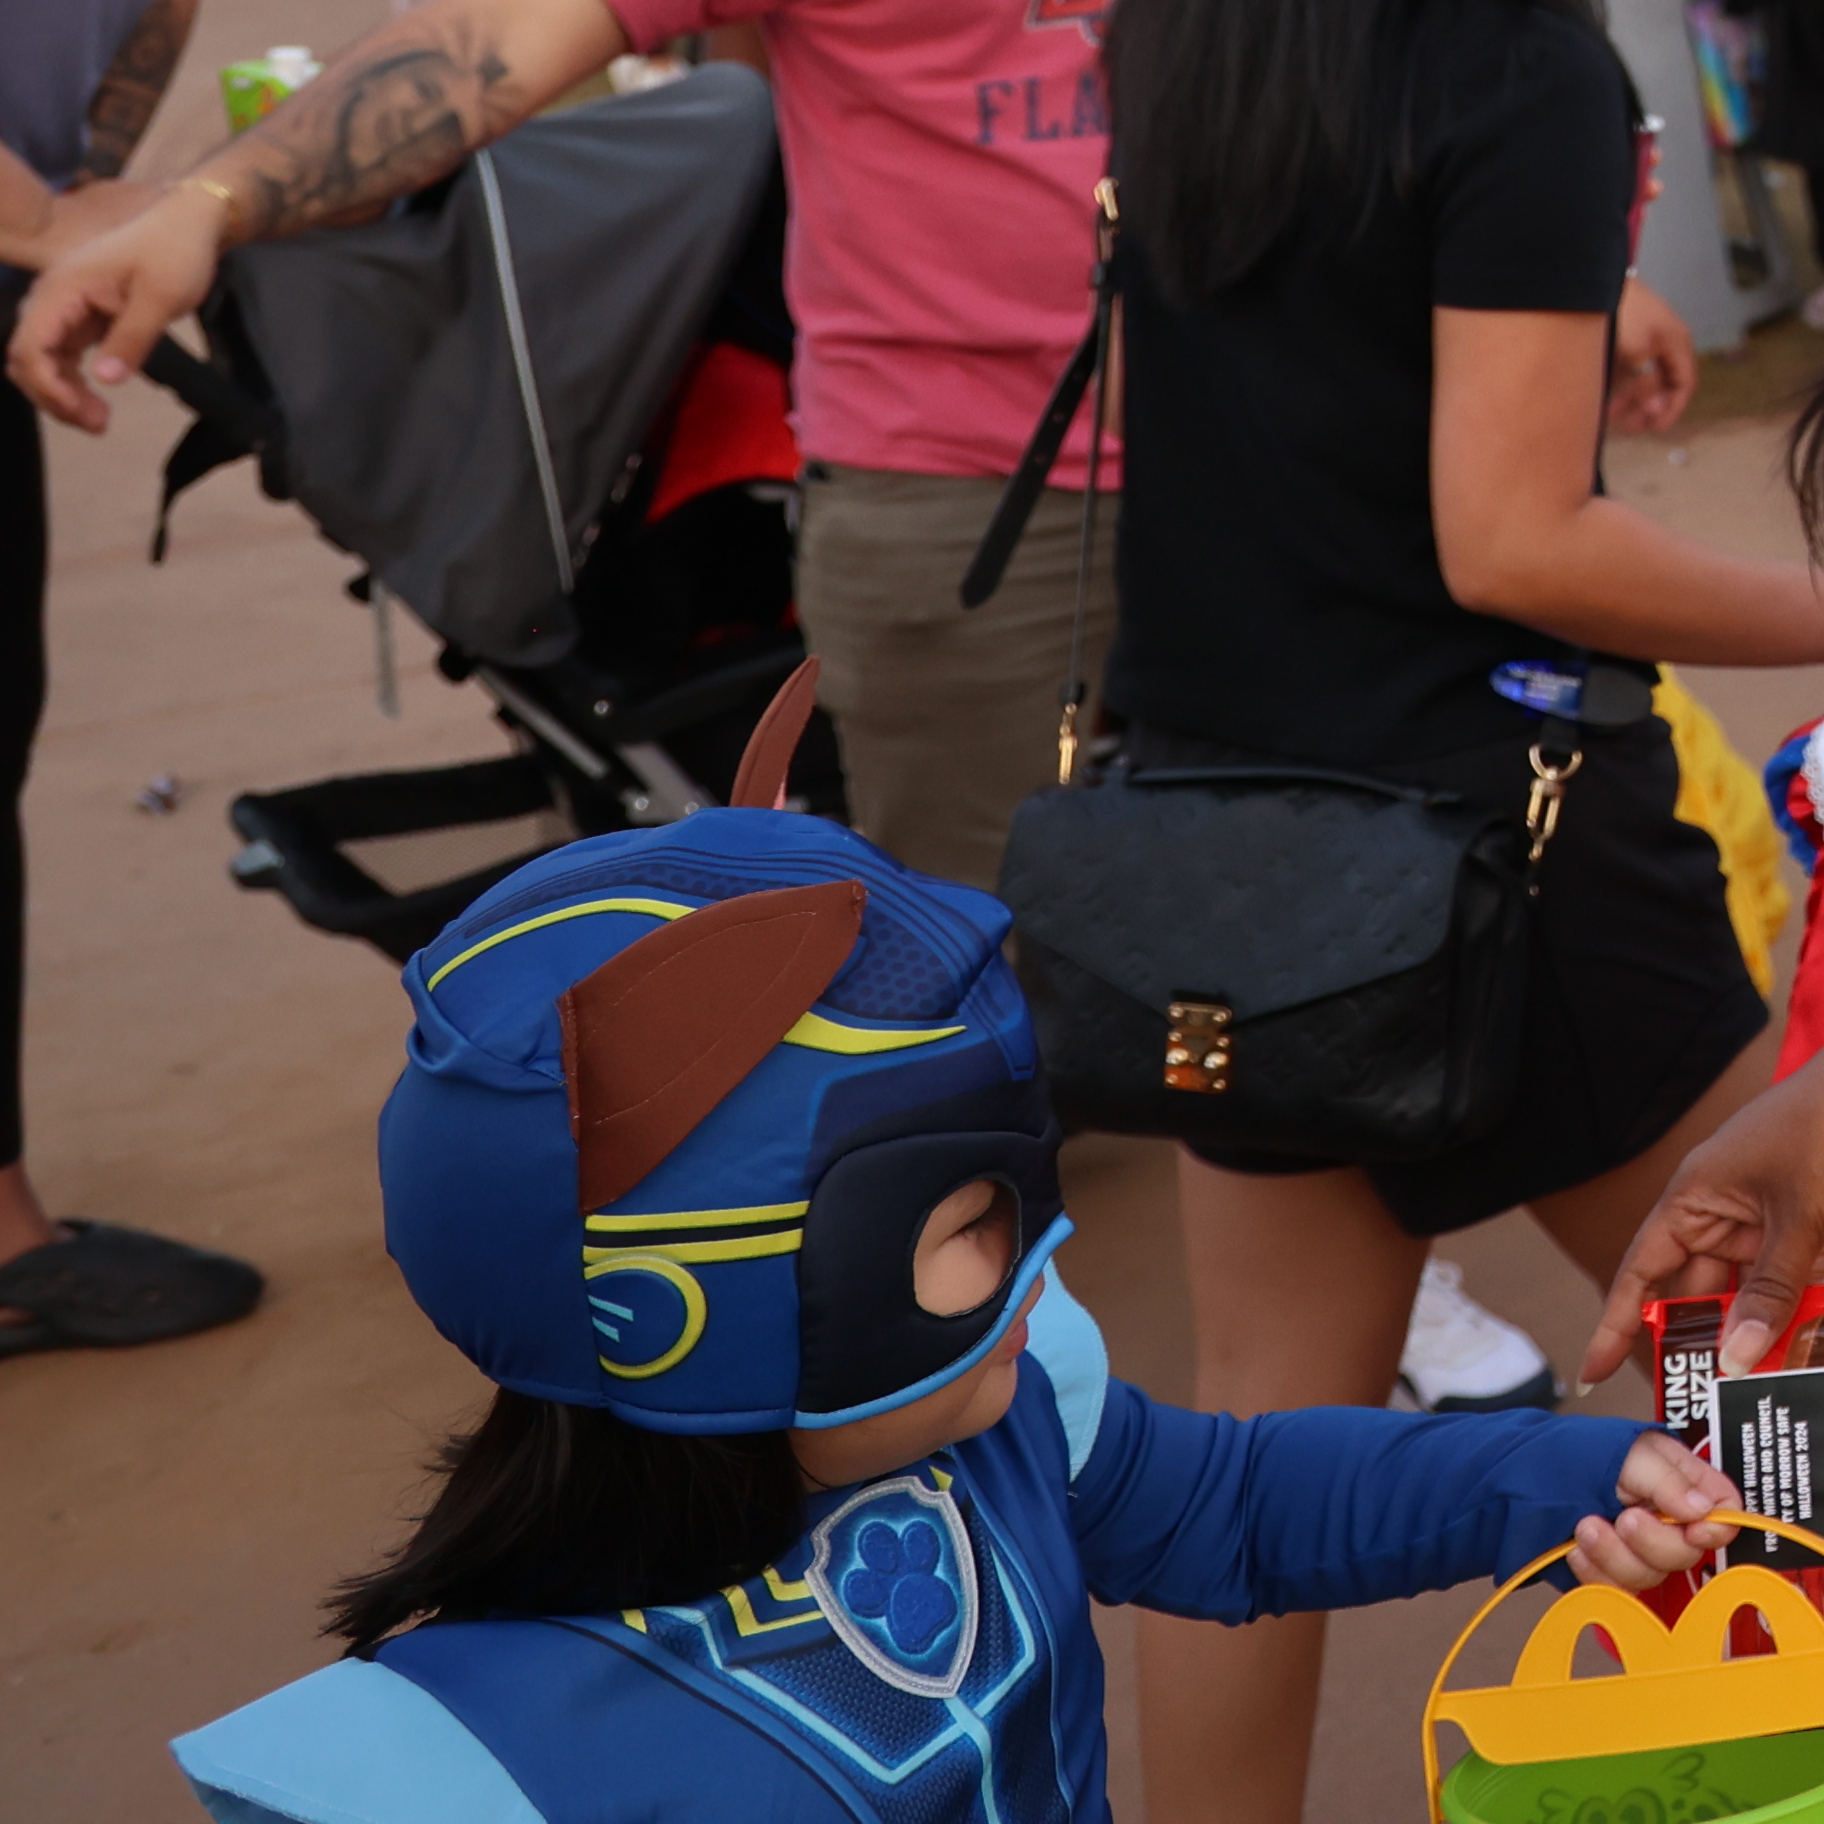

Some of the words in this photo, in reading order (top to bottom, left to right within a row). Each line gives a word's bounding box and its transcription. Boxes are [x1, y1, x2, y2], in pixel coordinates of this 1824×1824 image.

[1664, 1352, 1690, 1430] KING
[1688, 1350, 1714, 1421] SIZE
[1757, 1394, 1773, 1447] COUNCIL
[1775, 1406, 1790, 1436] SAFE
[1794, 1420, 1808, 1452] 2024
[1741, 1422, 1757, 1488] HALLOWEEN
[1760, 1450, 1775, 1474] AND
[1777, 1437, 1793, 1489] MORROW
[1761, 1475, 1777, 1517] MAYOR
[1779, 1488, 1794, 1507] OF
[1796, 1454, 1812, 1520] HALLOWEEN
[1764, 1528, 1778, 1553] FRO
